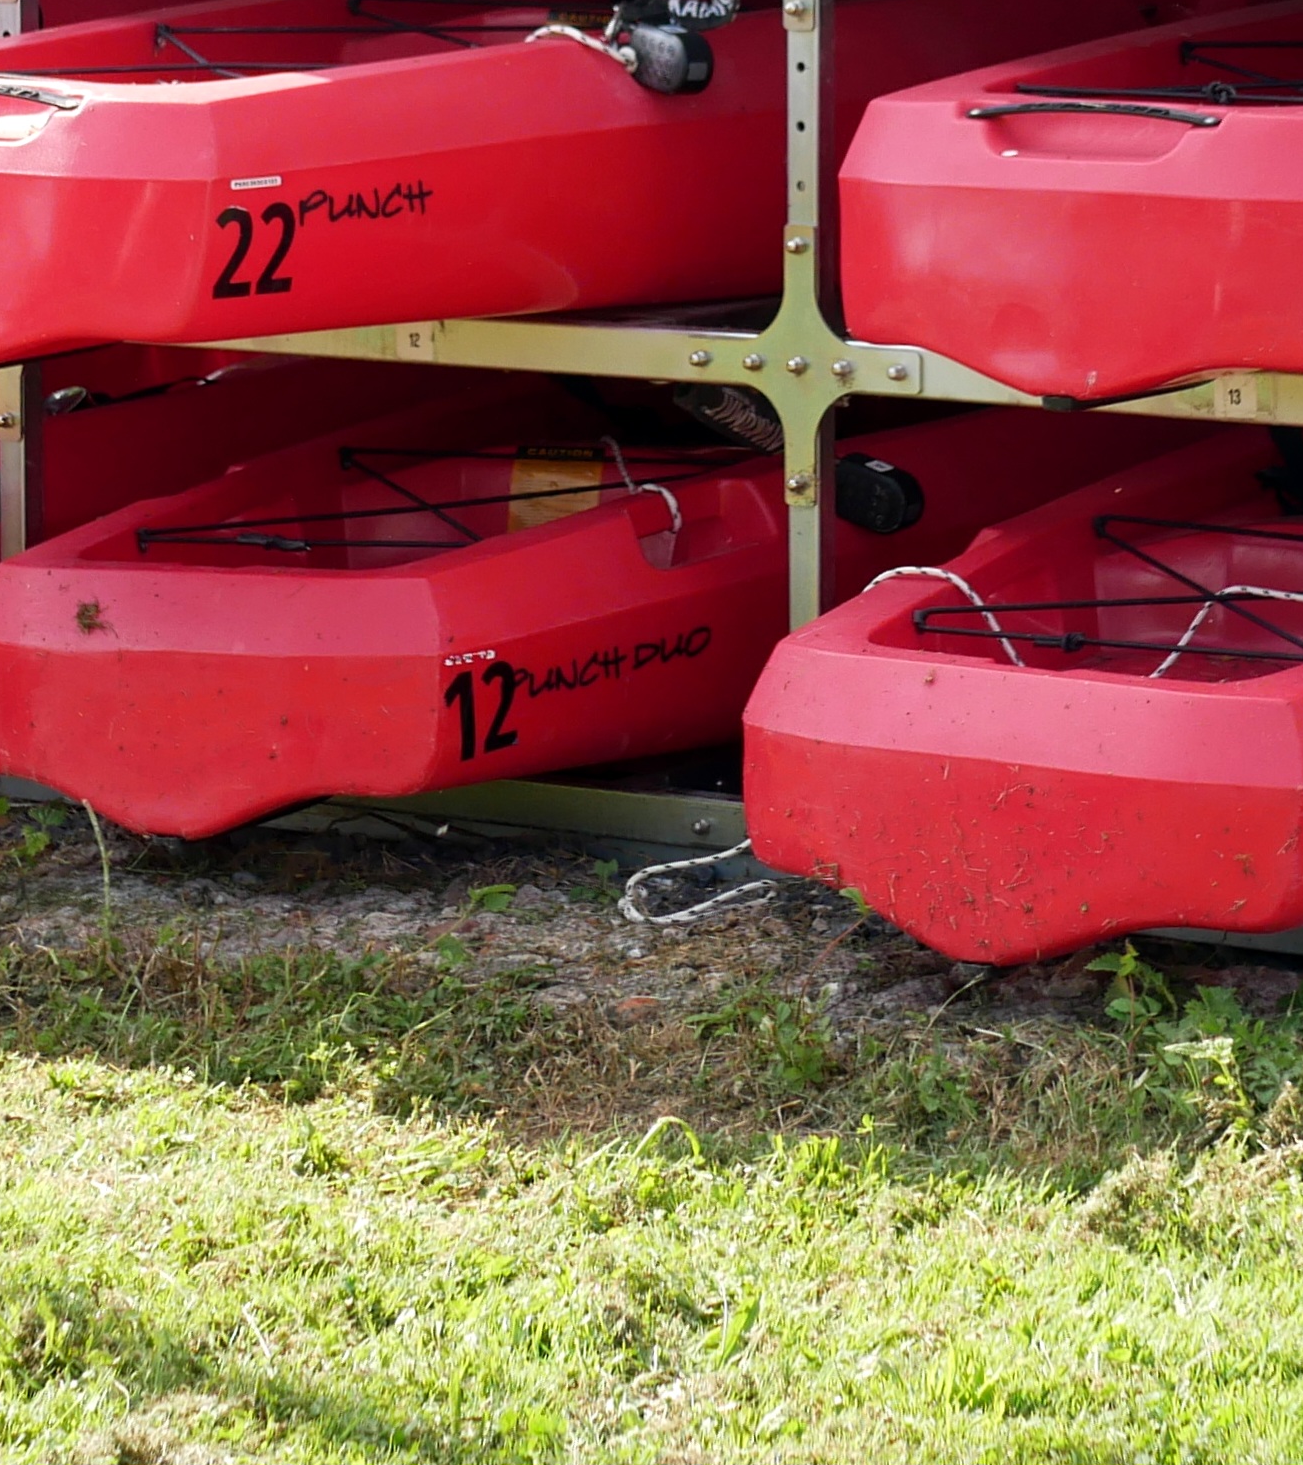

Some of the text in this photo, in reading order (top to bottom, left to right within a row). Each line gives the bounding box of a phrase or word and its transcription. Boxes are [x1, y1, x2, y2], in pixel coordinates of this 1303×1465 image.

[298, 180, 434, 226] PUNCH
[211, 202, 296, 300] 22
[409, 332, 421, 348] 12
[1227, 388, 1243, 406] 13
[527, 447, 594, 458] CAUTION
[509, 625, 713, 699] PUNCH DUO
[443, 660, 518, 762] 12
